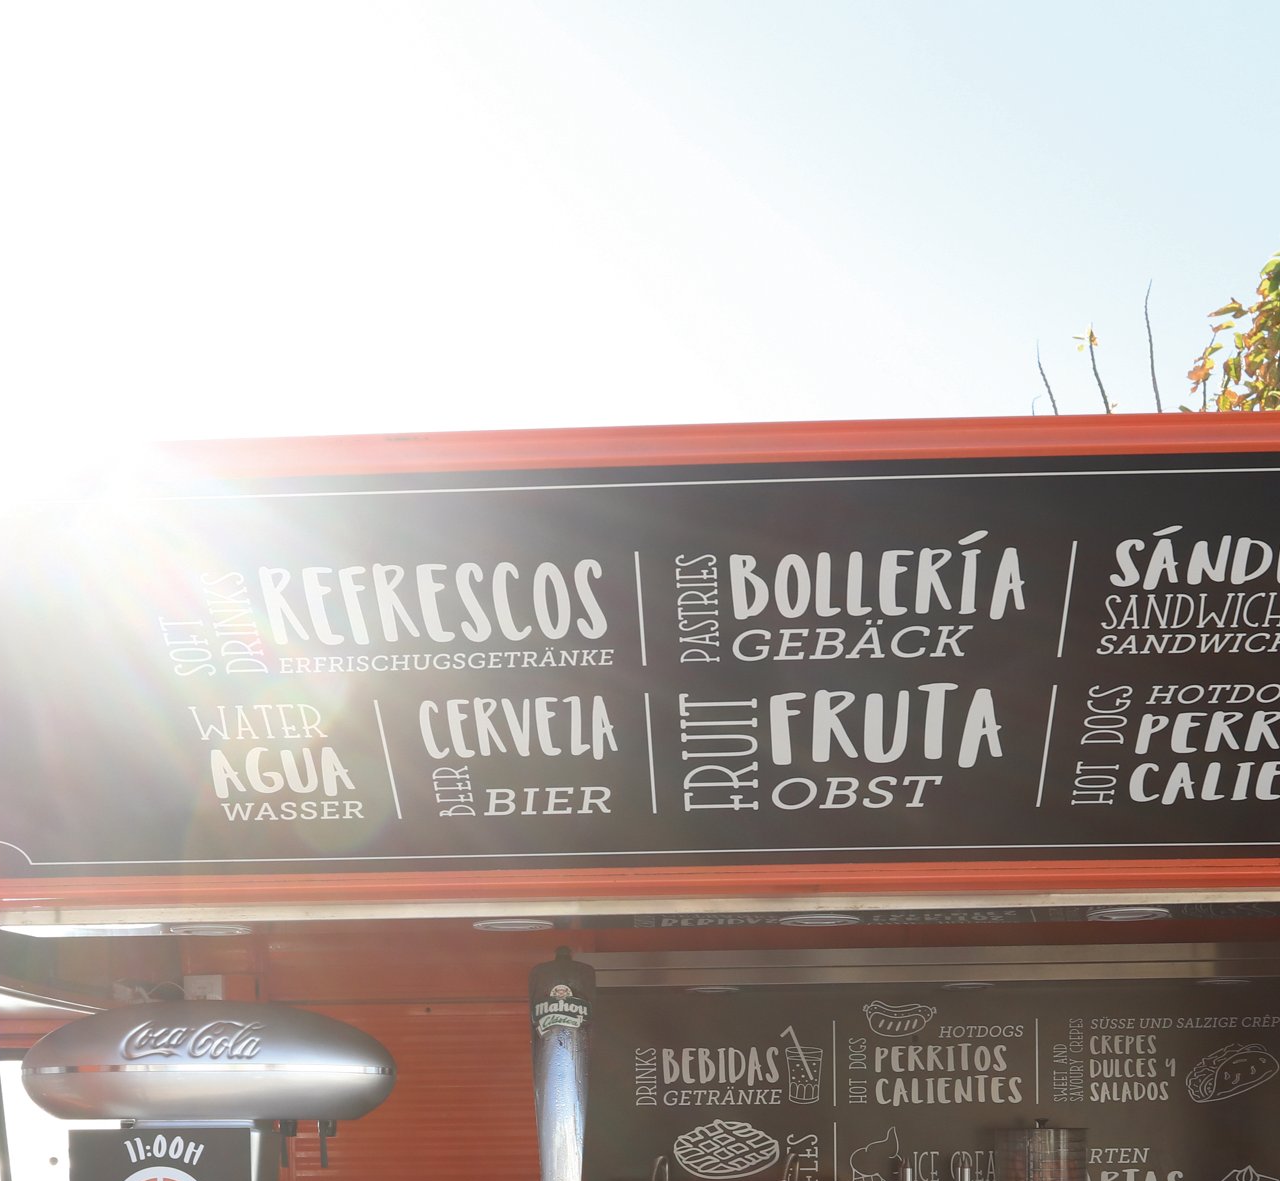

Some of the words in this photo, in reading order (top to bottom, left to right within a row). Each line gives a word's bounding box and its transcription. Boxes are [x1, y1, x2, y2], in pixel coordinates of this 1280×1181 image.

[729, 530, 1025, 620] BOLLERÍA
[258, 559, 608, 645] REFRESCOS
[675, 553, 721, 664] PASTRIES
[200, 570, 269, 675] DRINKS
[158, 615, 217, 677] SOFT
[732, 619, 974, 662] GEBÄCK
[278, 648, 615, 674] ERFRISCHUGSGETRÄNKE
[188, 703, 328, 741] WATER
[420, 695, 618, 761] CERVEZA
[770, 682, 1003, 769] FRUTA
[1080, 685, 1133, 745] DOGS
[678, 693, 759, 812] FRUIT
[210, 747, 355, 799] AGUA
[1071, 761, 1120, 806] HOT
[432, 765, 476, 818] BEER
[484, 786, 612, 817] BIER
[771, 776, 943, 810] OBST
[221, 800, 365, 822] WASSER
[535, 999, 588, 1017] Mahou
[1090, 1015, 1135, 1030] SÜSSE
[1139, 1017, 1173, 1030] UND
[1176, 1016, 1238, 1030] SALZIGE
[120, 1019, 266, 1061] Coca-Cola
[938, 1025, 1024, 1039] HOTDOGS
[1069, 1017, 1083, 1053] CREPES
[1089, 1034, 1157, 1056] CREPES
[662, 1046, 780, 1087] BEBIDAS
[848, 1037, 867, 1070] DOGS
[874, 1043, 1007, 1073] PERRITOS
[1053, 1043, 1067, 1067] AND
[1089, 1056, 1157, 1079] DULCES
[635, 1046, 657, 1107] DRINKS
[848, 1079, 867, 1105] HOT
[875, 1074, 1023, 1107] CALIENTES
[1053, 1071, 1068, 1102] SWEET
[1069, 1058, 1084, 1102] SAVOURY
[1089, 1081, 1169, 1103] SALADOS
[663, 1086, 782, 1106] GETRÄNKE
[123, 1133, 205, 1167] 11:00H
[1087, 1147, 1150, 1164] RTEN
